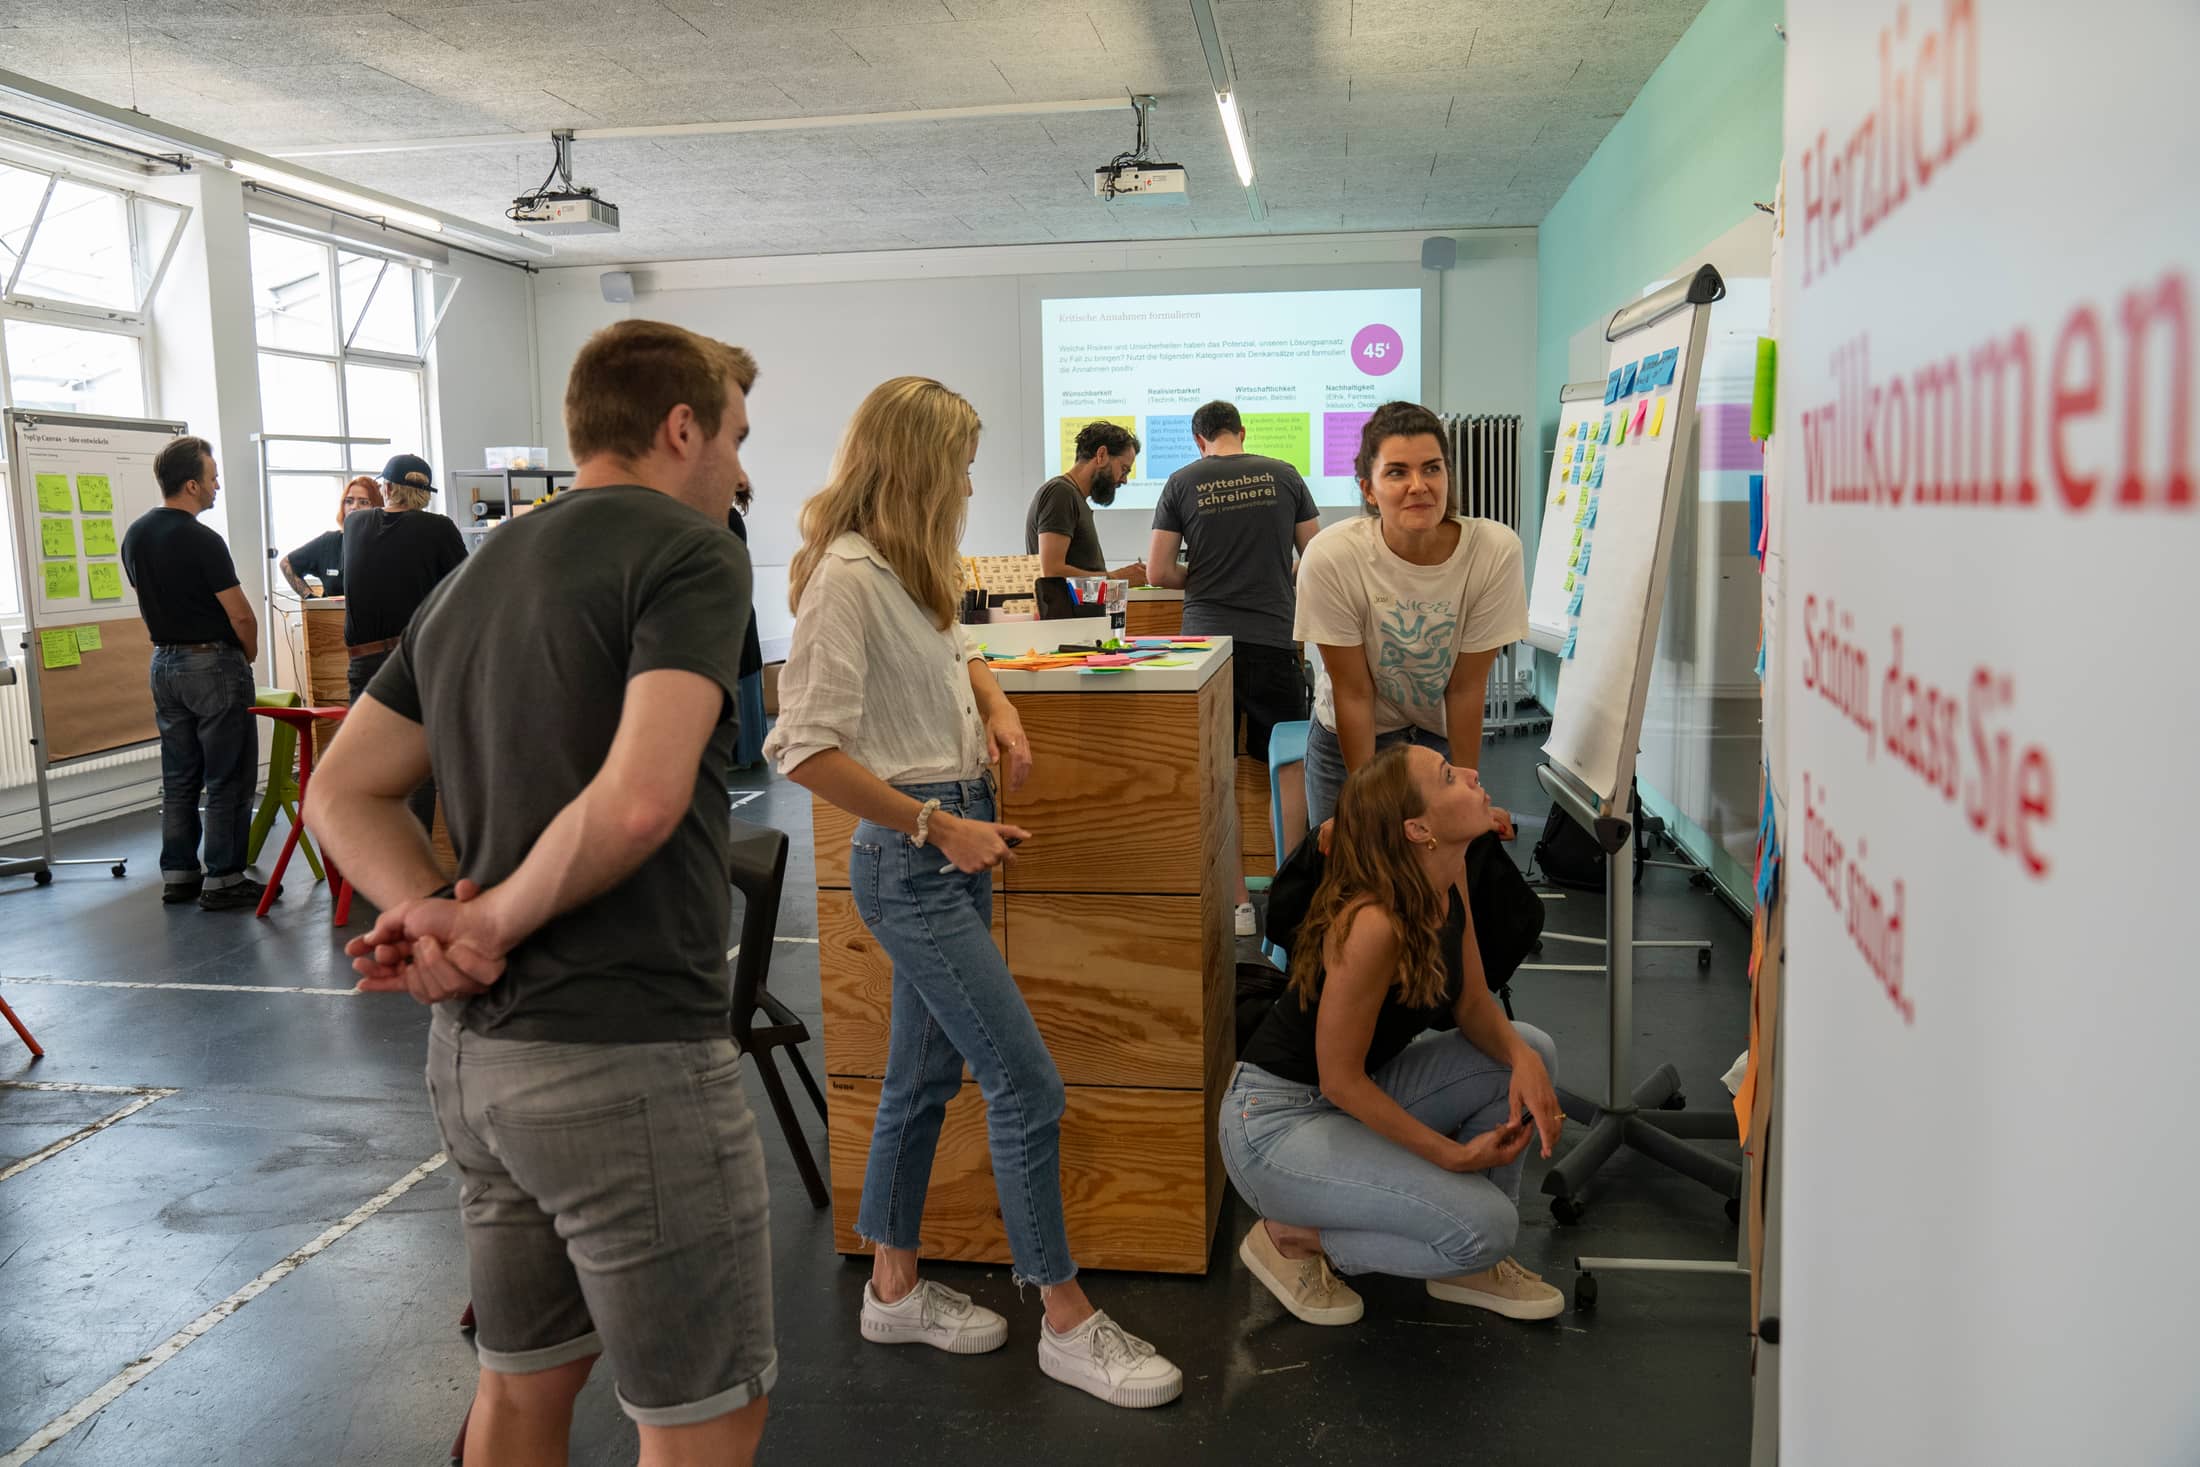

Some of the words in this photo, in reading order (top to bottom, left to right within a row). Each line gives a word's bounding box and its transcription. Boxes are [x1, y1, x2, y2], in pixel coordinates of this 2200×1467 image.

[1802, 0, 1981, 288] Herzlich
[1100, 311, 1147, 321] Annahmen
[1149, 309, 1201, 320] formulieren
[1148, 387, 1201, 395] Realisierbarkeit
[1235, 385, 1296, 393] Wirtschaftlichkeit
[1325, 384, 1375, 392] Nachhaltigkeit
[1801, 270, 2198, 516] willkommen
[1196, 472, 1275, 492] wyttenbach
[1197, 486, 1277, 508] schreinerei
[1803, 593, 1877, 763] Schön,
[1882, 625, 1960, 804] dass
[1964, 665, 2054, 881] Sie
[1803, 771, 1844, 912] hier
